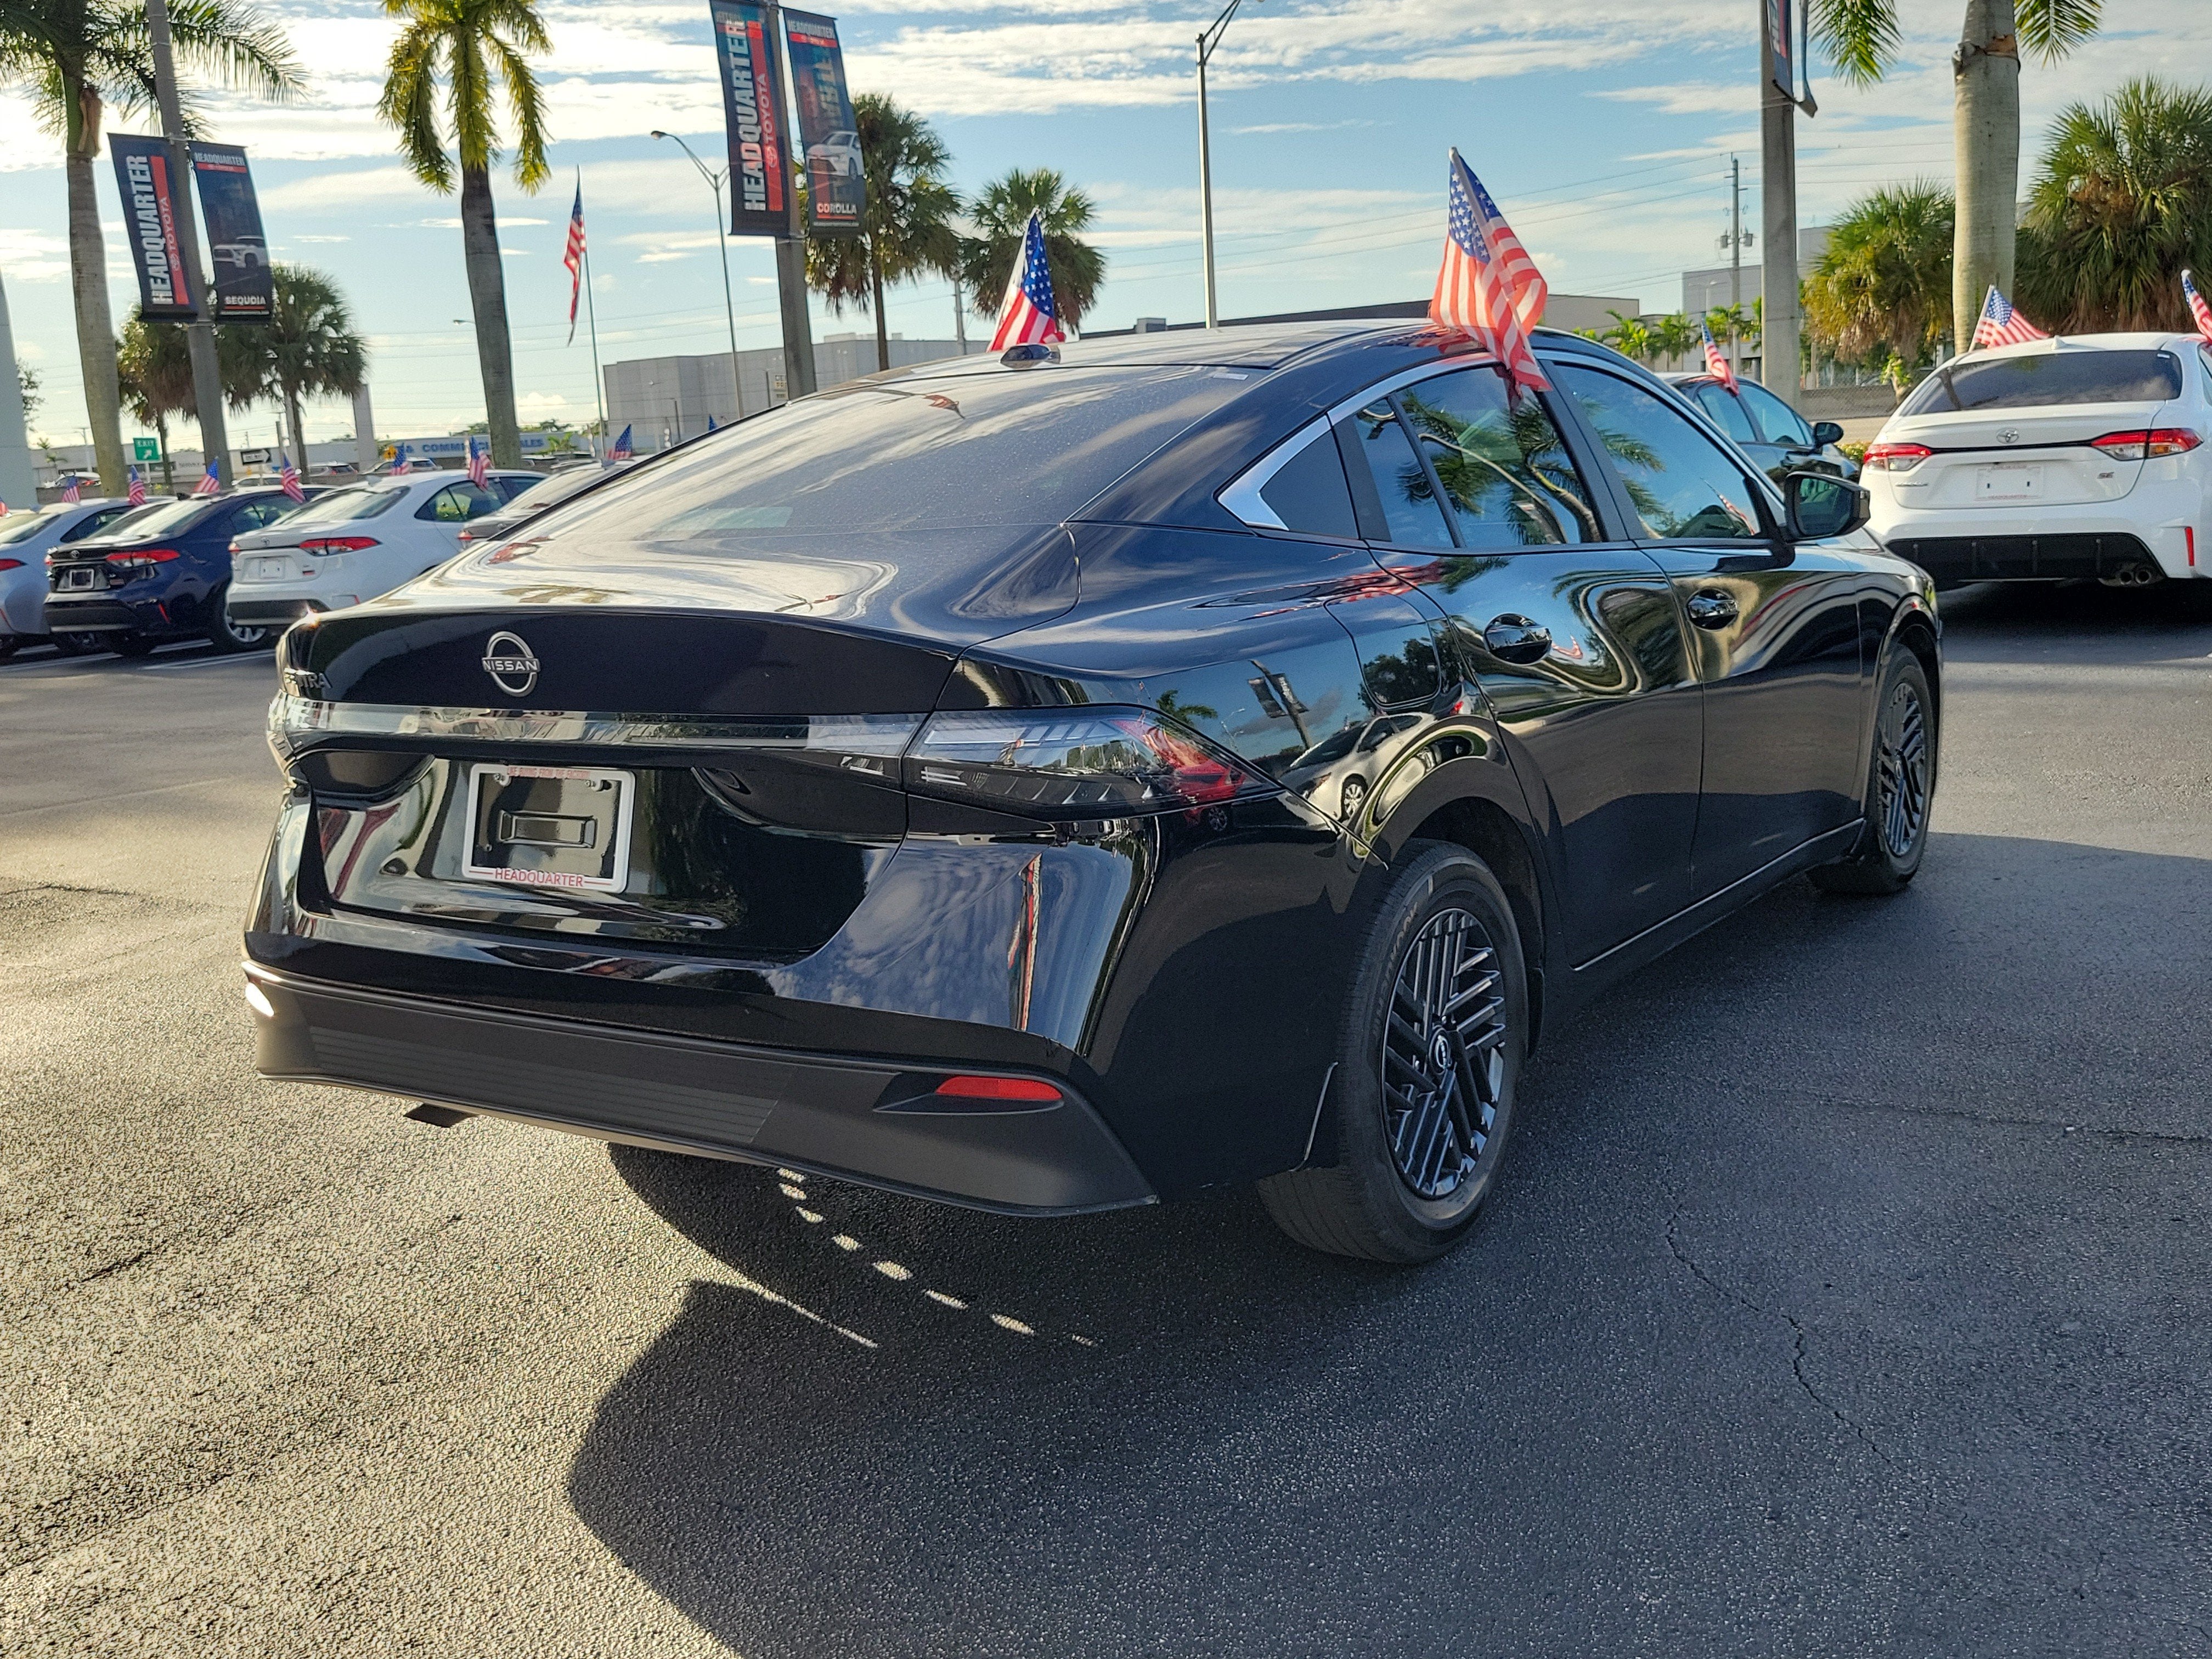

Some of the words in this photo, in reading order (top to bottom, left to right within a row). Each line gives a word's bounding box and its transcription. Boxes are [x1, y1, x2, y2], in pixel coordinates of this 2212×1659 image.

[725, 20, 766, 211] HEADQUARTER
[757, 74, 777, 143] TOYOTA
[160, 197, 177, 252] TOYOTA
[816, 202, 857, 215] COROLLA
[126, 155, 173, 304] HEADQUARTER
[224, 295, 266, 306] SEQUOIA
[483, 661, 538, 670] NISSAN
[495, 869, 583, 887] HEADQUARTER
